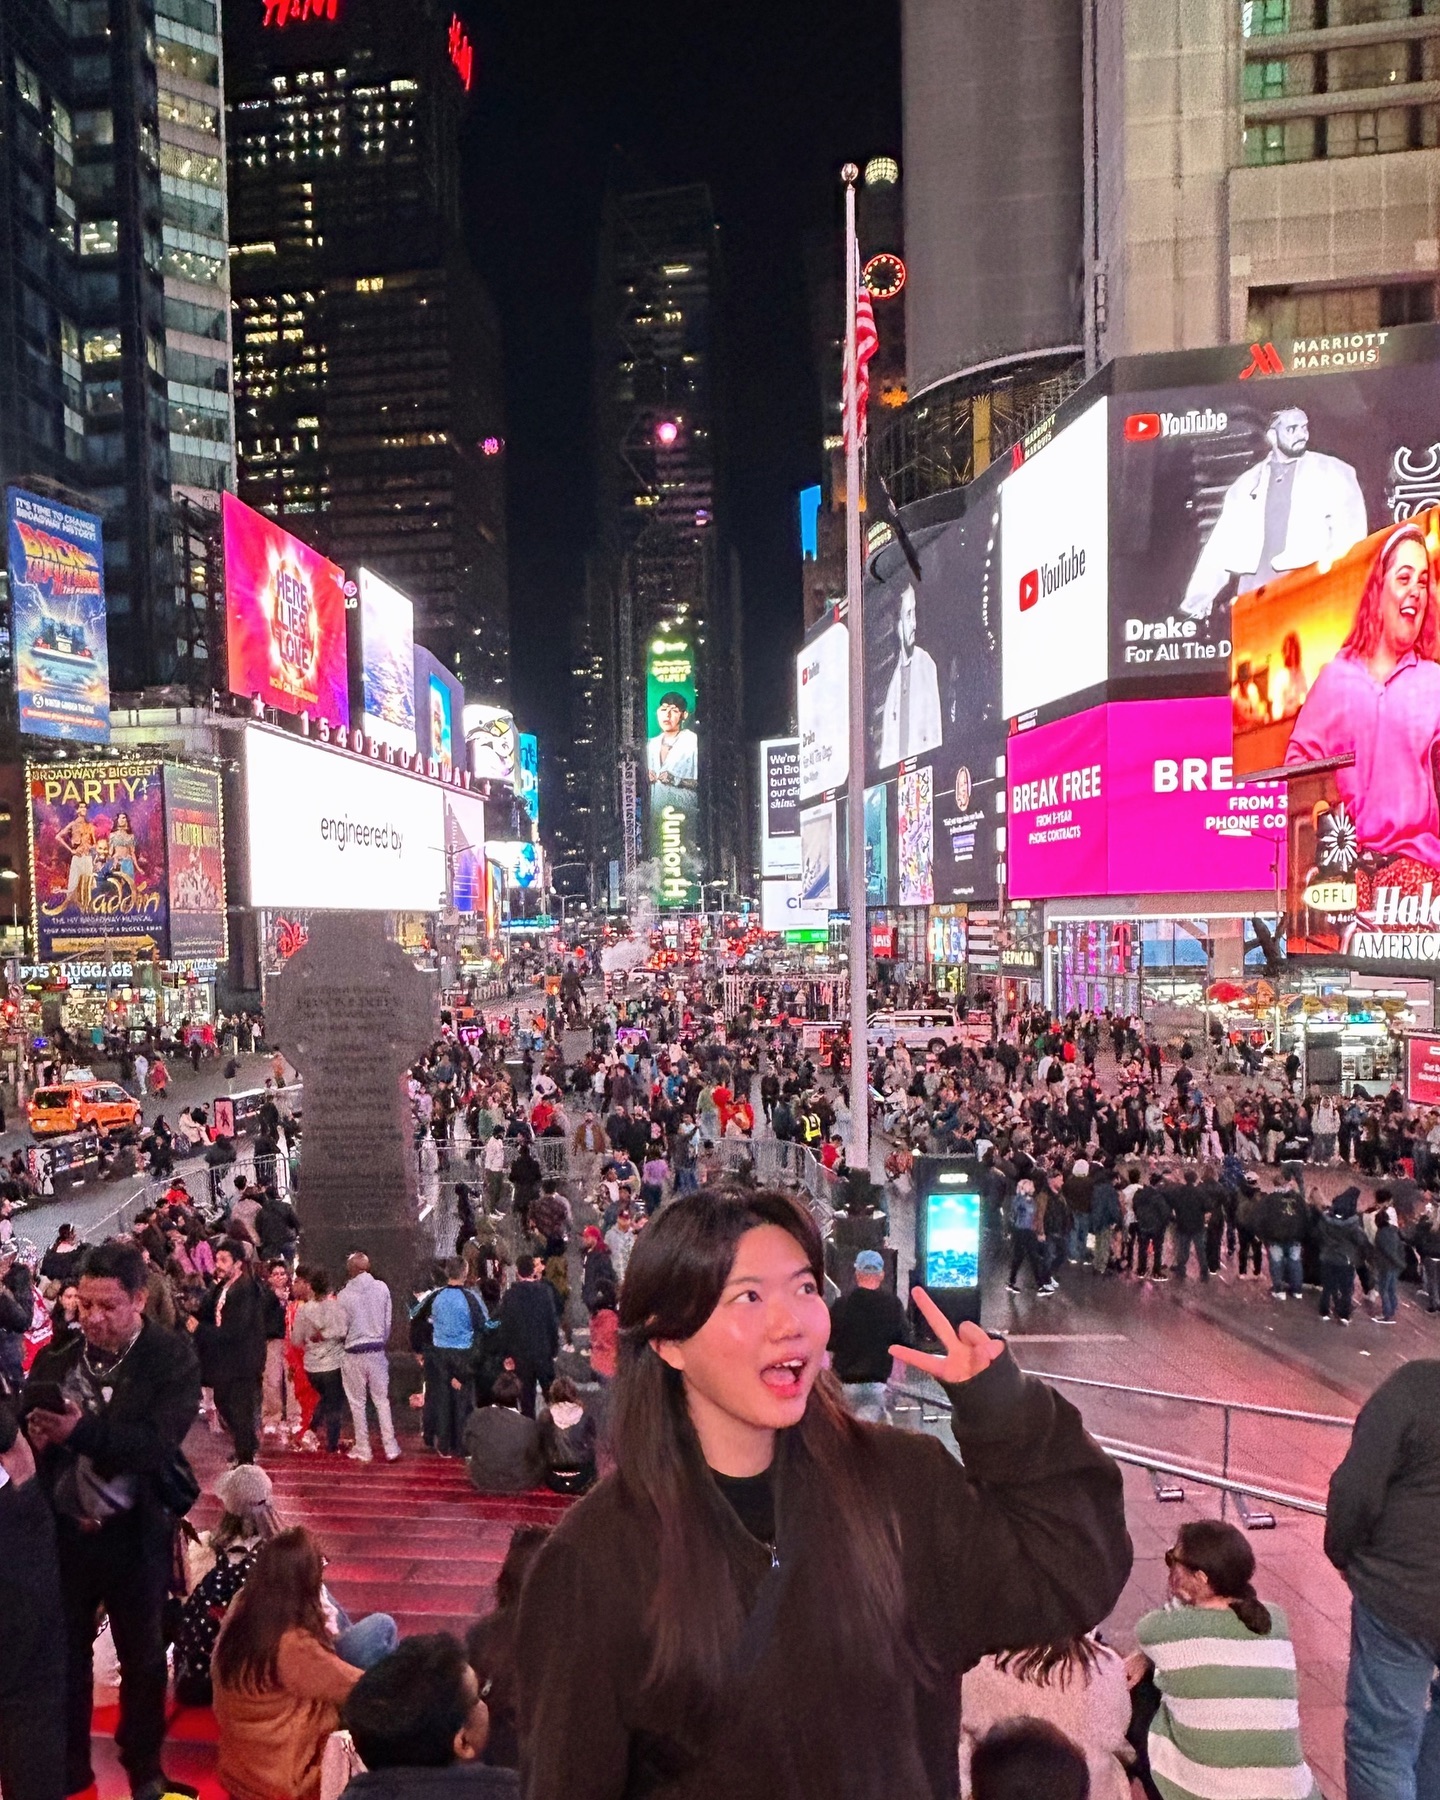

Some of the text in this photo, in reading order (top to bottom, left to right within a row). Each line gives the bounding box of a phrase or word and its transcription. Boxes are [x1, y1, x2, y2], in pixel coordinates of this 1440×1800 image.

[1293, 332, 1389, 353] MARRIOTT
[1293, 349, 1378, 369] MARQUIS
[1024, 413, 1056, 445] MARRIOTT
[1159, 408, 1228, 437] YouTube
[1041, 545, 1086, 598] YouTube
[276, 569, 308, 612] HERE
[345, 598, 358, 609] LG
[280, 600, 306, 640] LIES
[1125, 616, 1197, 641] Drake
[280, 634, 309, 671] LOVE
[1125, 646, 1154, 663] For
[1154, 643, 1180, 661] All
[1182, 642, 1216, 659] The
[301, 711, 363, 753] 1540
[369, 736, 472, 790] BROADWAY
[770, 753, 797, 765] We're
[31, 765, 158, 781] BROADWAY'S BIGGEST
[770, 767, 783, 776] on
[770, 777, 787, 787] but
[770, 789, 786, 798] our
[1012, 764, 1101, 814] BREAK FREE
[1229, 795, 1274, 811] FROM
[1205, 813, 1287, 830] PHONE CO
[320, 813, 403, 859] engineered by
[662, 805, 688, 898] Junior H
[41, 872, 161, 916] Aladdin
[1358, 934, 1440, 960] AMERIC
